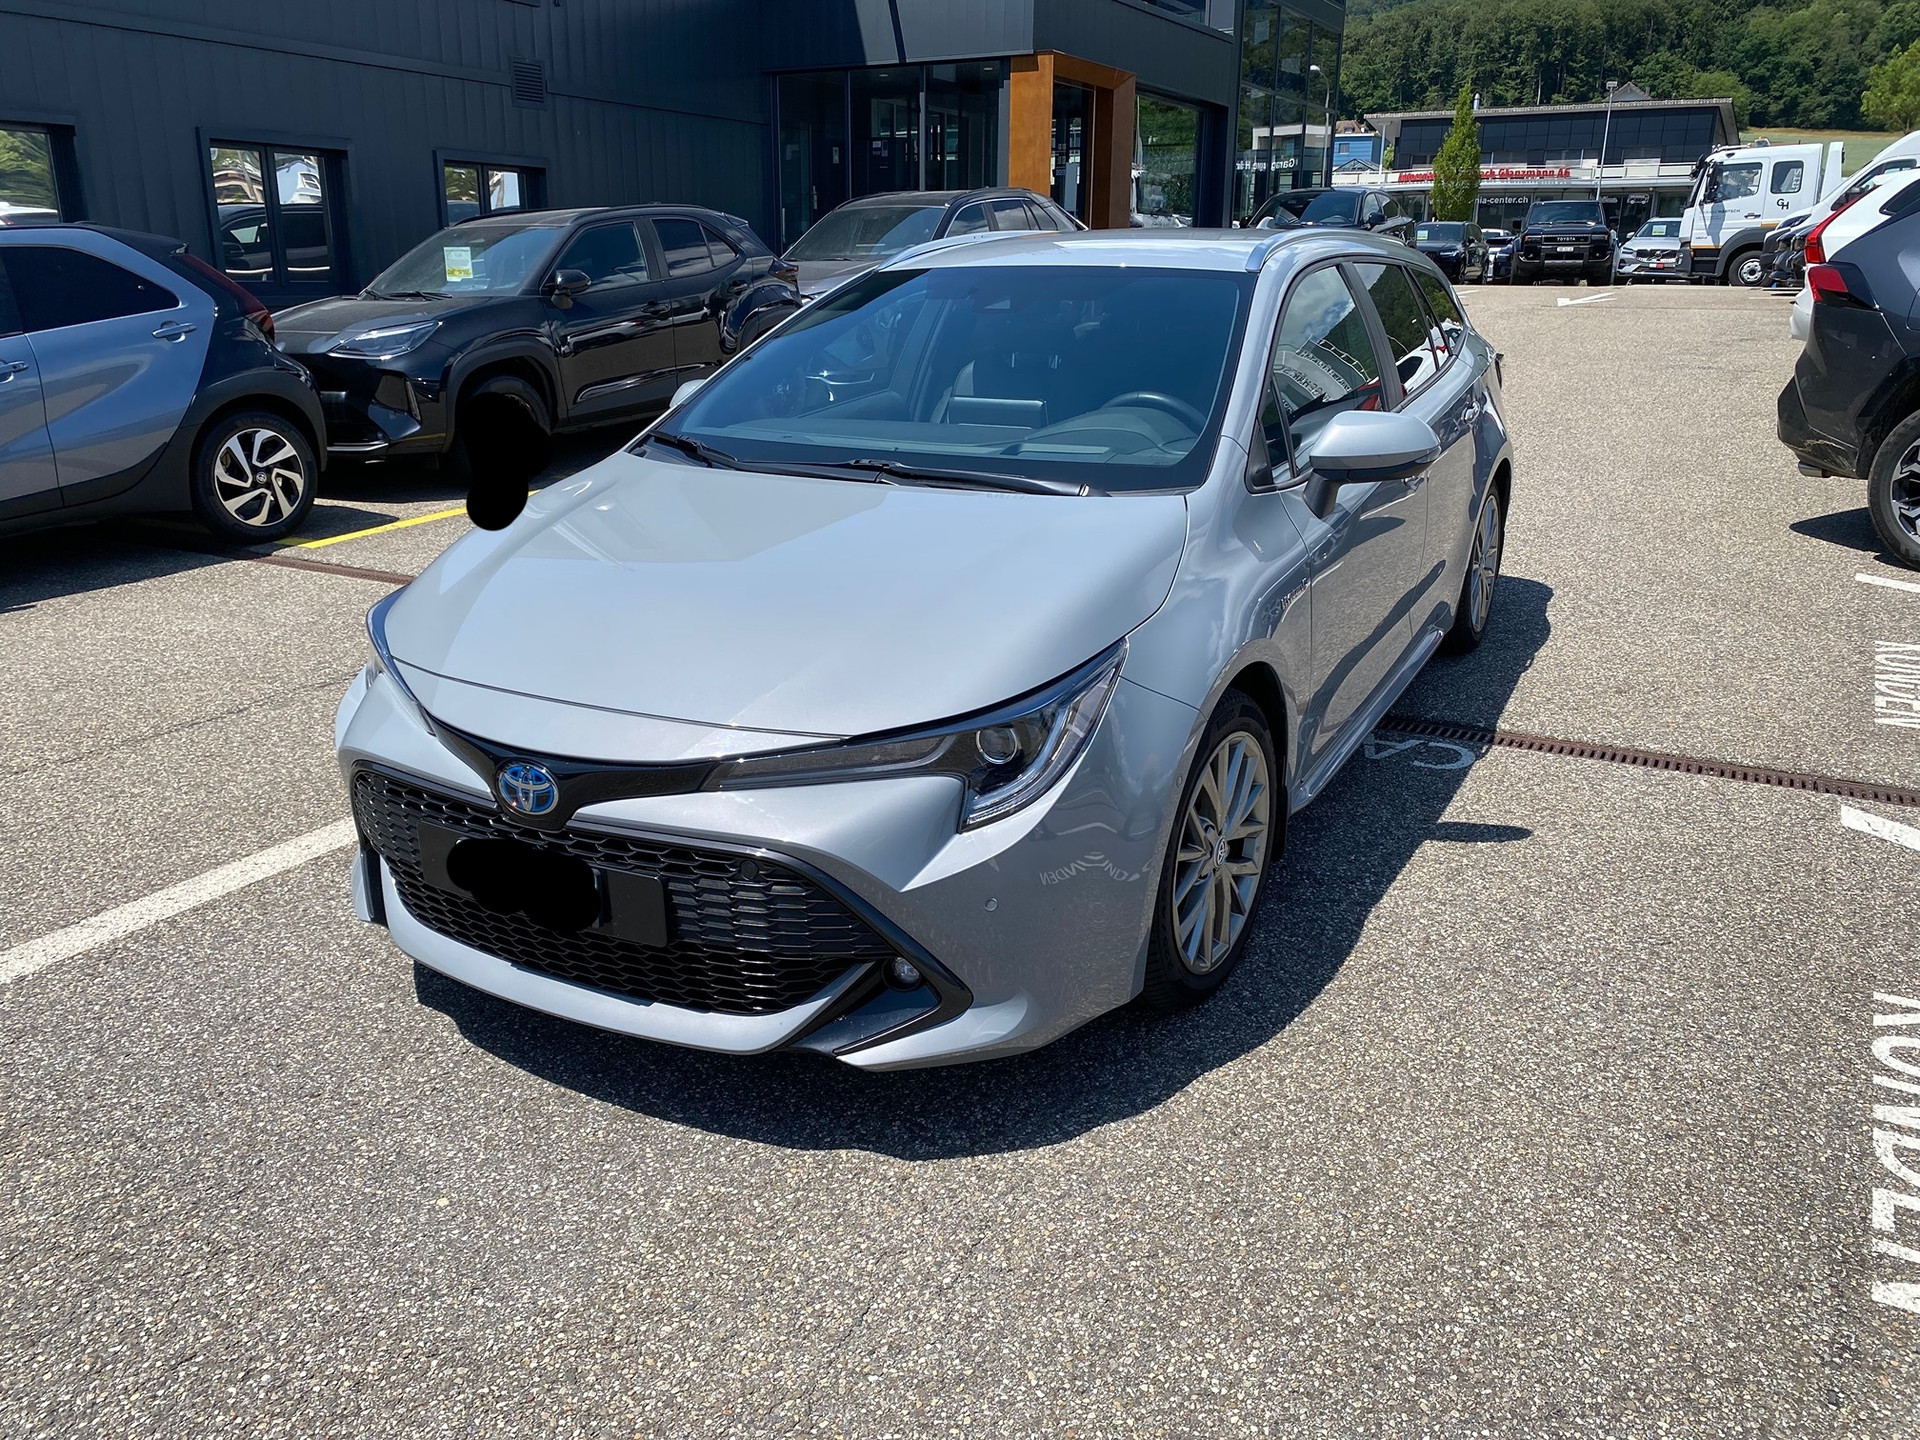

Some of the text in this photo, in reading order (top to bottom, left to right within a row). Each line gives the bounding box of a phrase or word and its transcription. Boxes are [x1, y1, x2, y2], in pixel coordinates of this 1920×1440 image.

[1499, 167, 1555, 178] Glanzmann
[1557, 167, 1570, 177] AG
[1475, 196, 1528, 204] nia-center.ch
[1776, 198, 1790, 210] GH
